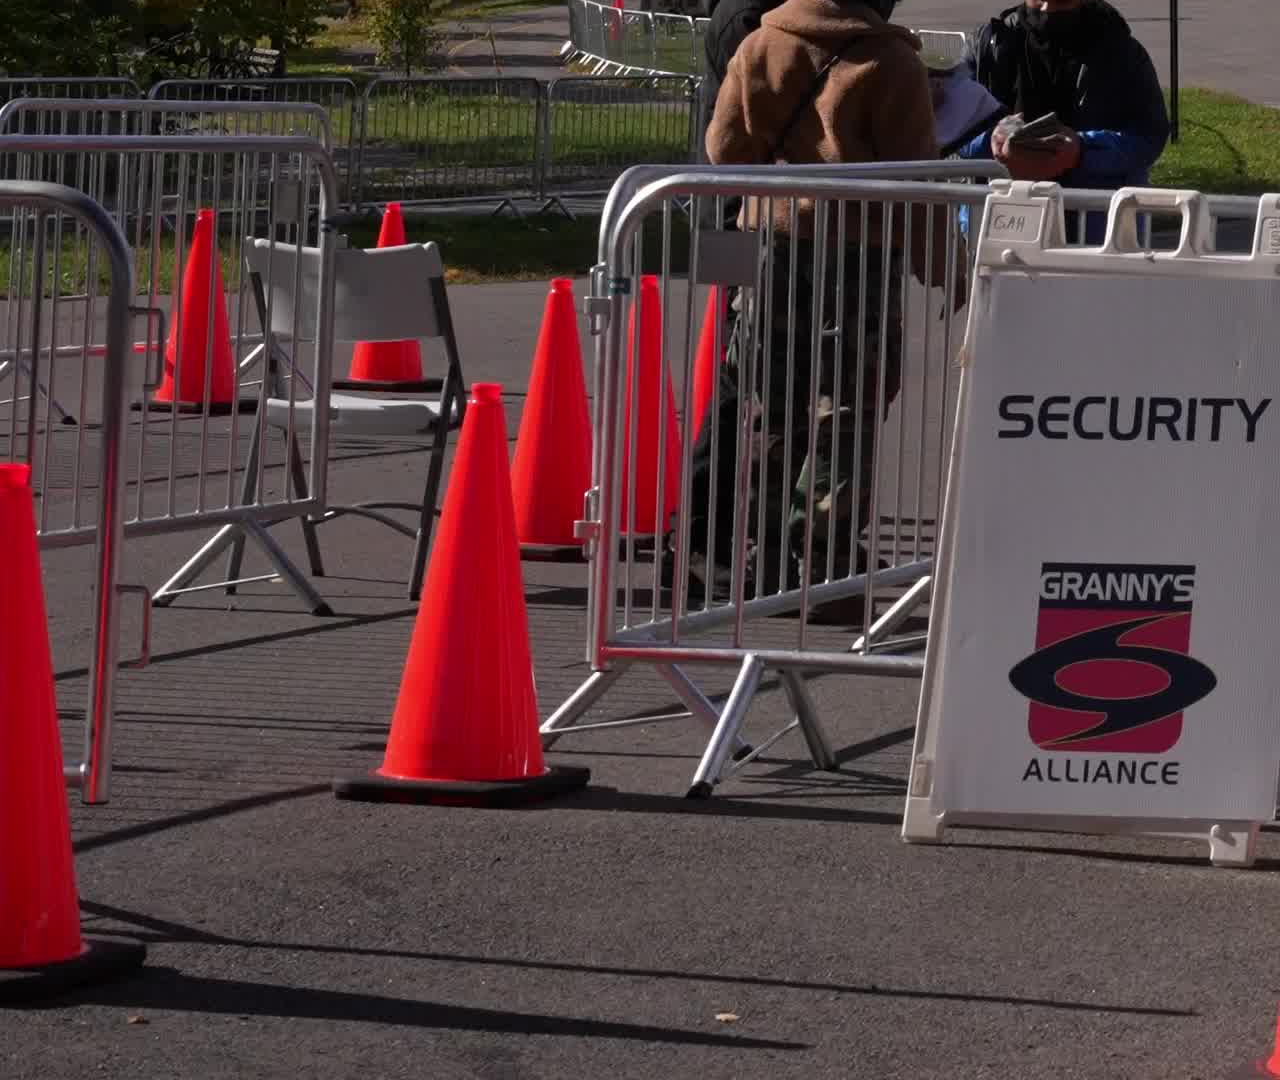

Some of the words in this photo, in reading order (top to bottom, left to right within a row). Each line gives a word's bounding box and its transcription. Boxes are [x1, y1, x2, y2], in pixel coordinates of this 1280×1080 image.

[998, 395, 1272, 442] SECURITY
[1040, 571, 1195, 602] GRANNY'S
[1023, 758, 1180, 785] ALLIANCE
